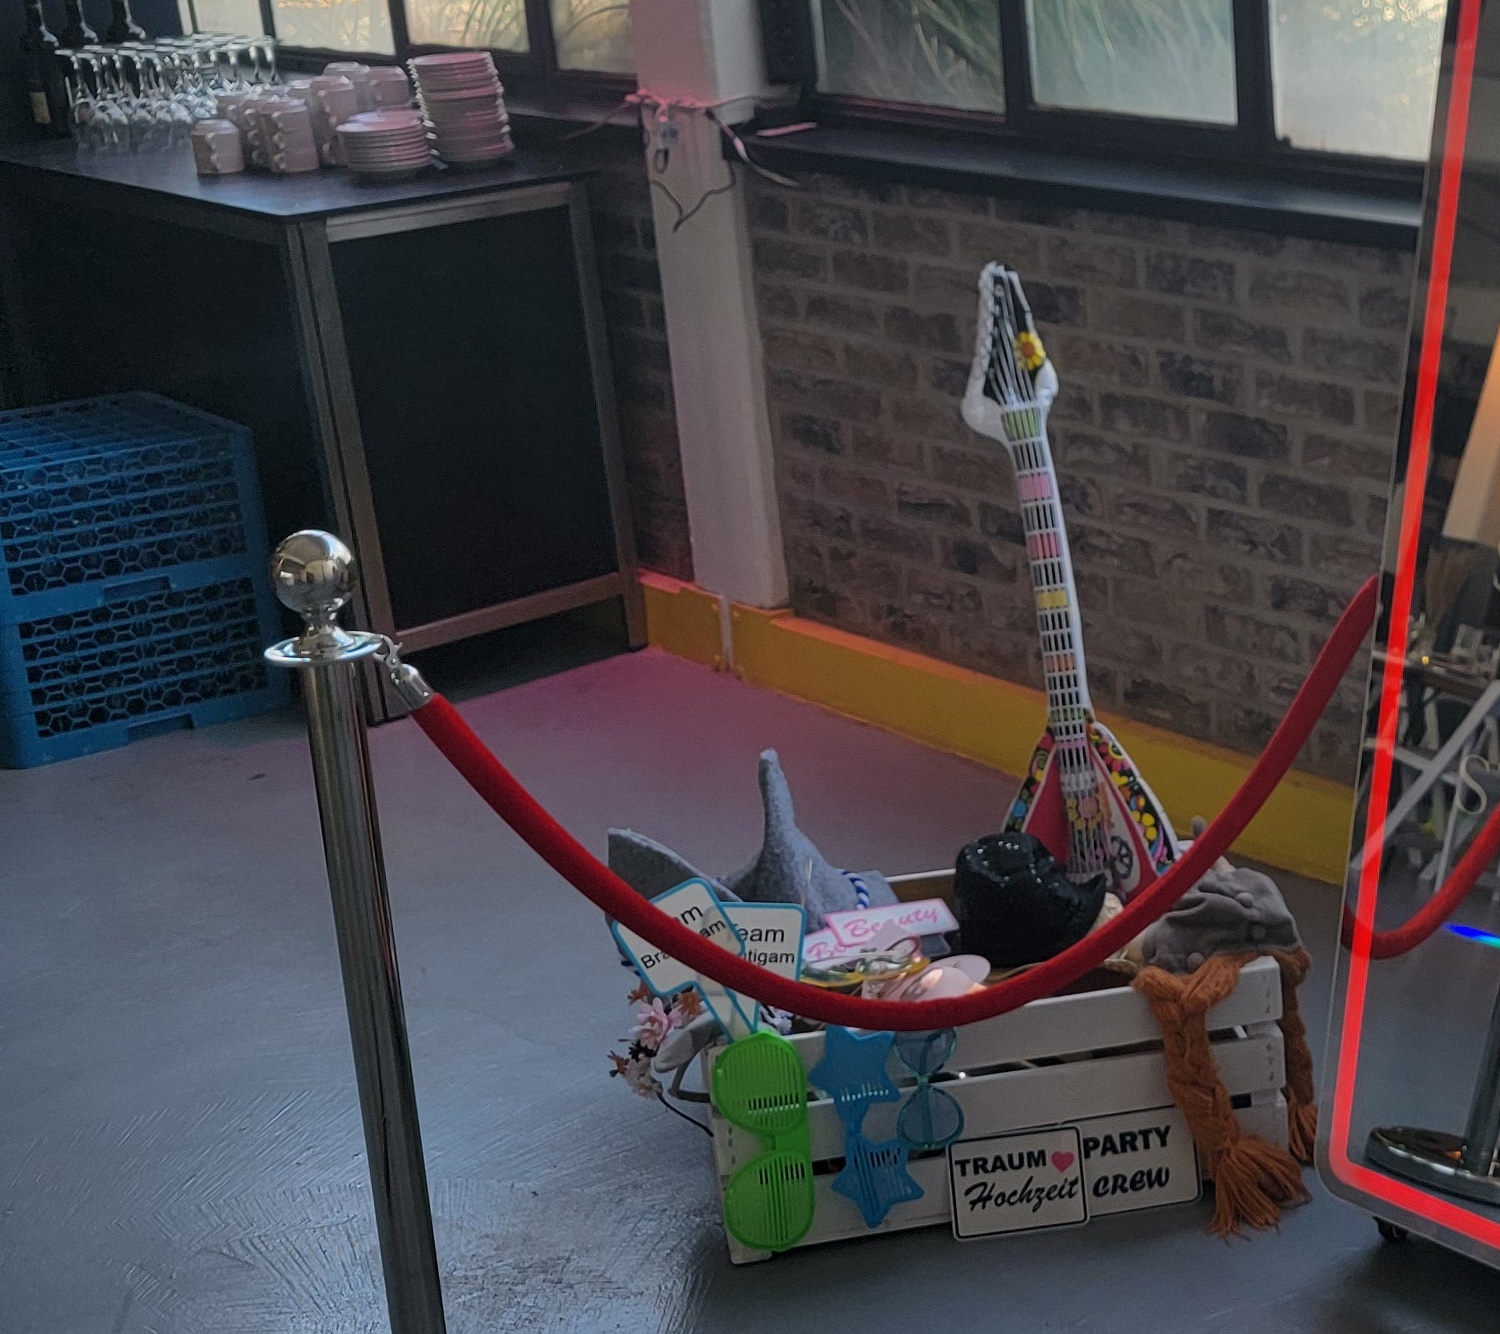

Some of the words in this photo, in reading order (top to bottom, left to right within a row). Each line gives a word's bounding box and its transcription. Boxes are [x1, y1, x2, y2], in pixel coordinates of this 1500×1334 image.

[734, 923, 785, 943] eam
[843, 908, 939, 938] Beuty
[1082, 1125, 1171, 1159] PARTY
[955, 1148, 1048, 1177] TRAUM
[963, 1175, 1080, 1213] Hochzeit
